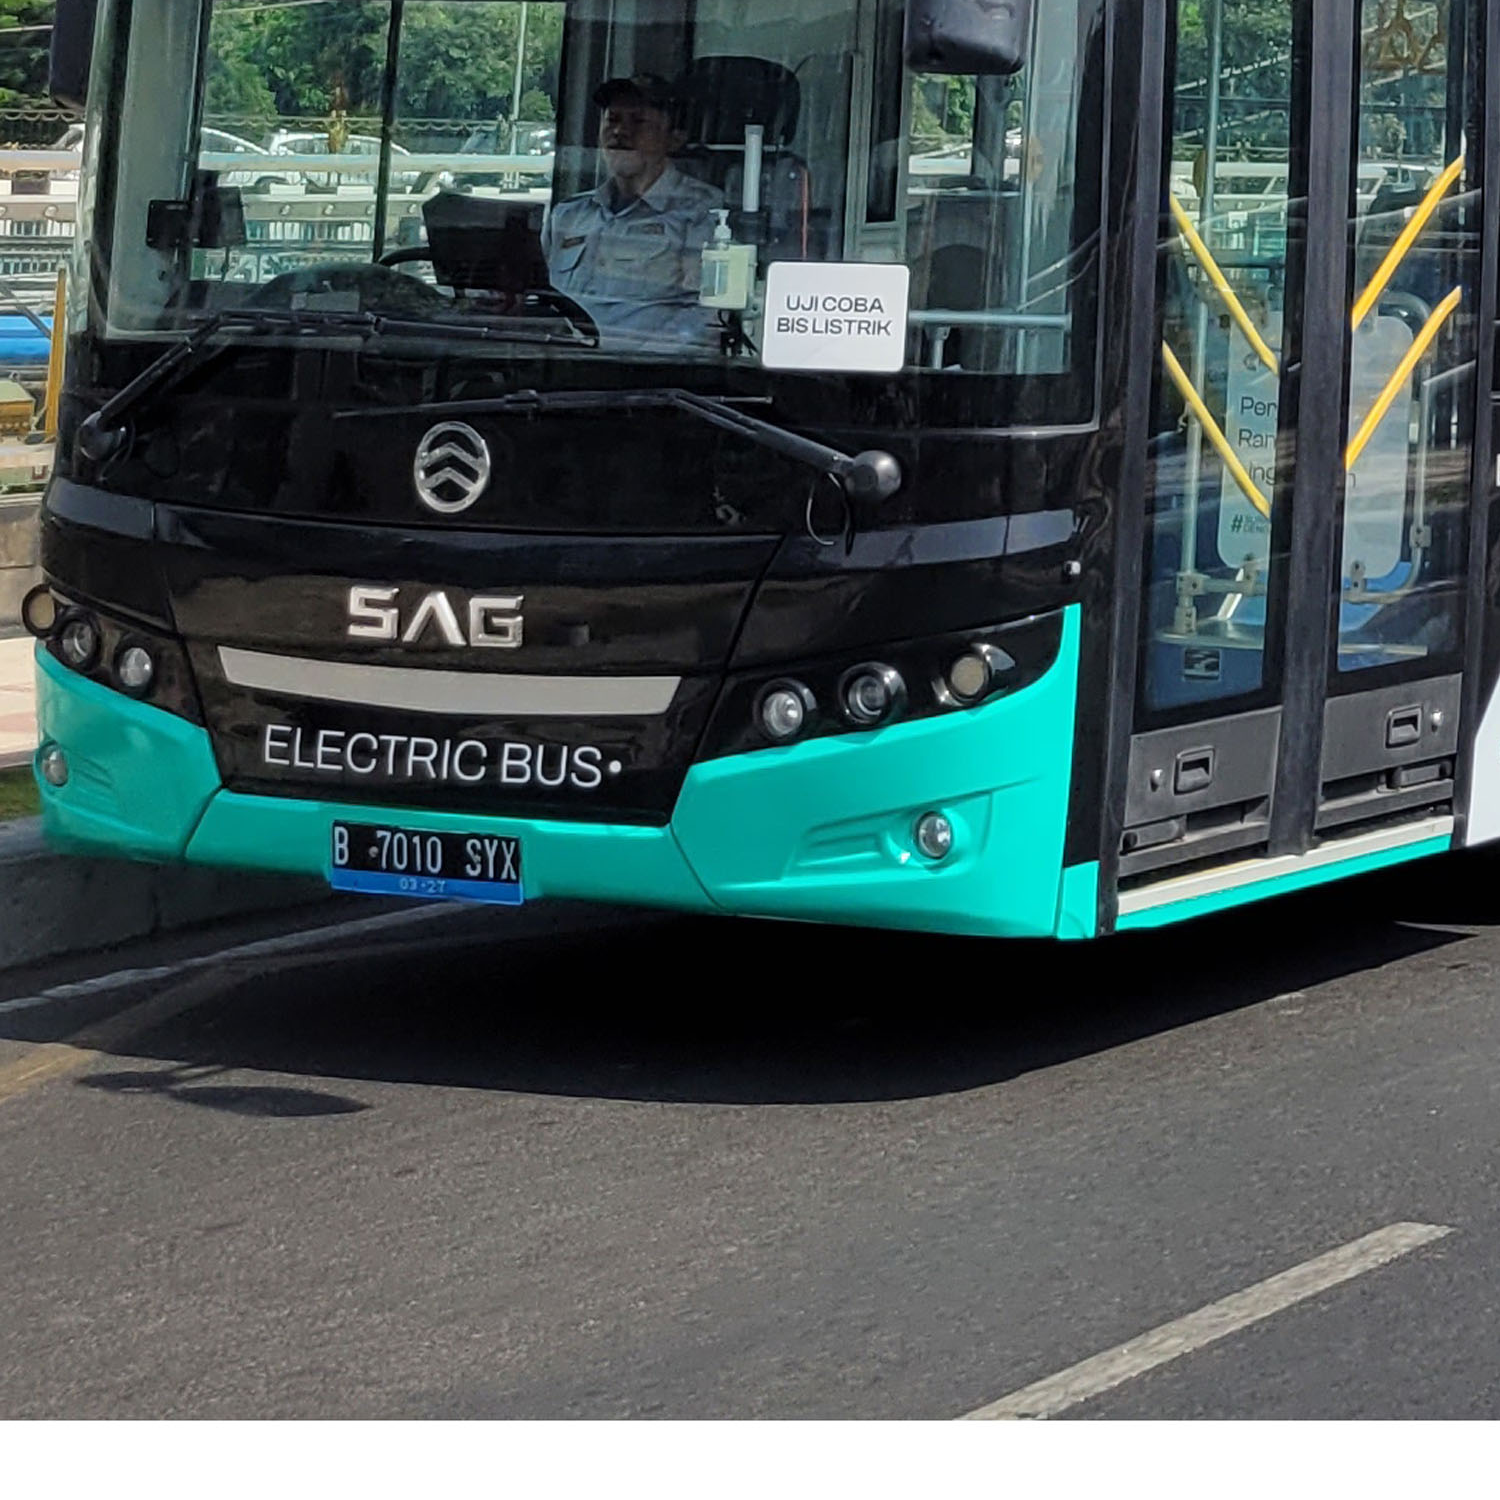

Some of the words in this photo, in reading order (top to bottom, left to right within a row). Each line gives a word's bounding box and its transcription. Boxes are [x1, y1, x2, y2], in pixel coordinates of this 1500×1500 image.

[776, 317, 808, 334] BIS
[811, 318, 892, 337] LISTRIK
[786, 295, 819, 312] UJI
[822, 296, 884, 313] COBA
[347, 585, 525, 649] SAG
[264, 723, 488, 782] ELECTRIC
[334, 826, 349, 866] B
[376, 830, 442, 874] 7010
[465, 838, 517, 881] SYX
